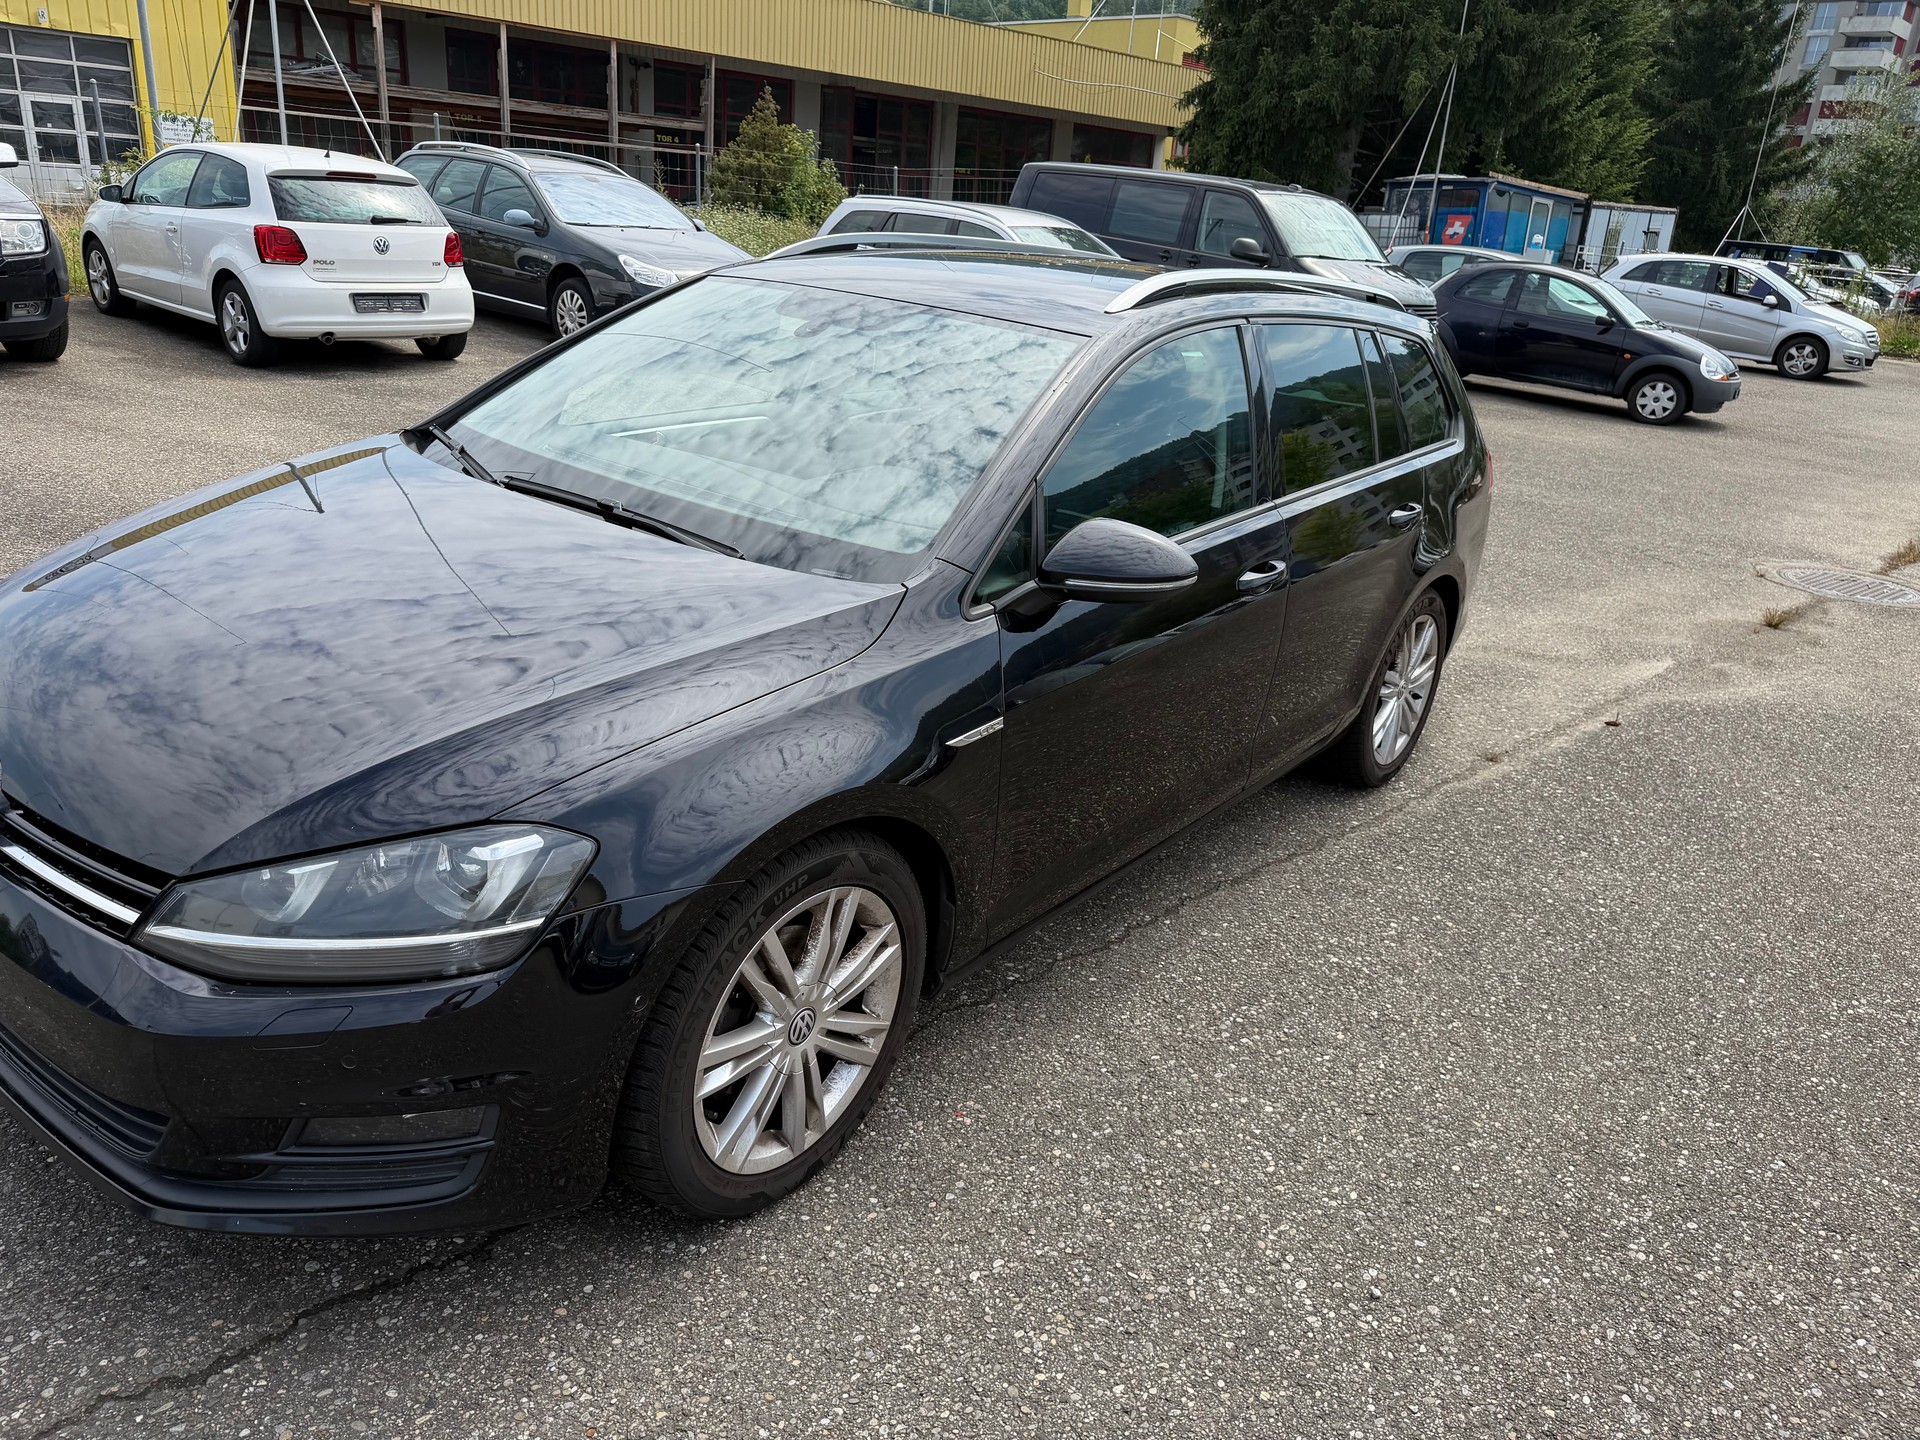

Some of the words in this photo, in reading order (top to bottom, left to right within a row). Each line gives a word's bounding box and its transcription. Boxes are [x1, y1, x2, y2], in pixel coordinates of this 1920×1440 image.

[163, 126, 179, 134] Garage
[656, 134, 673, 143] TOR
[673, 136, 680, 144] 4
[666, 905, 769, 1111] FROSTRACK
[773, 874, 810, 905] UHP
